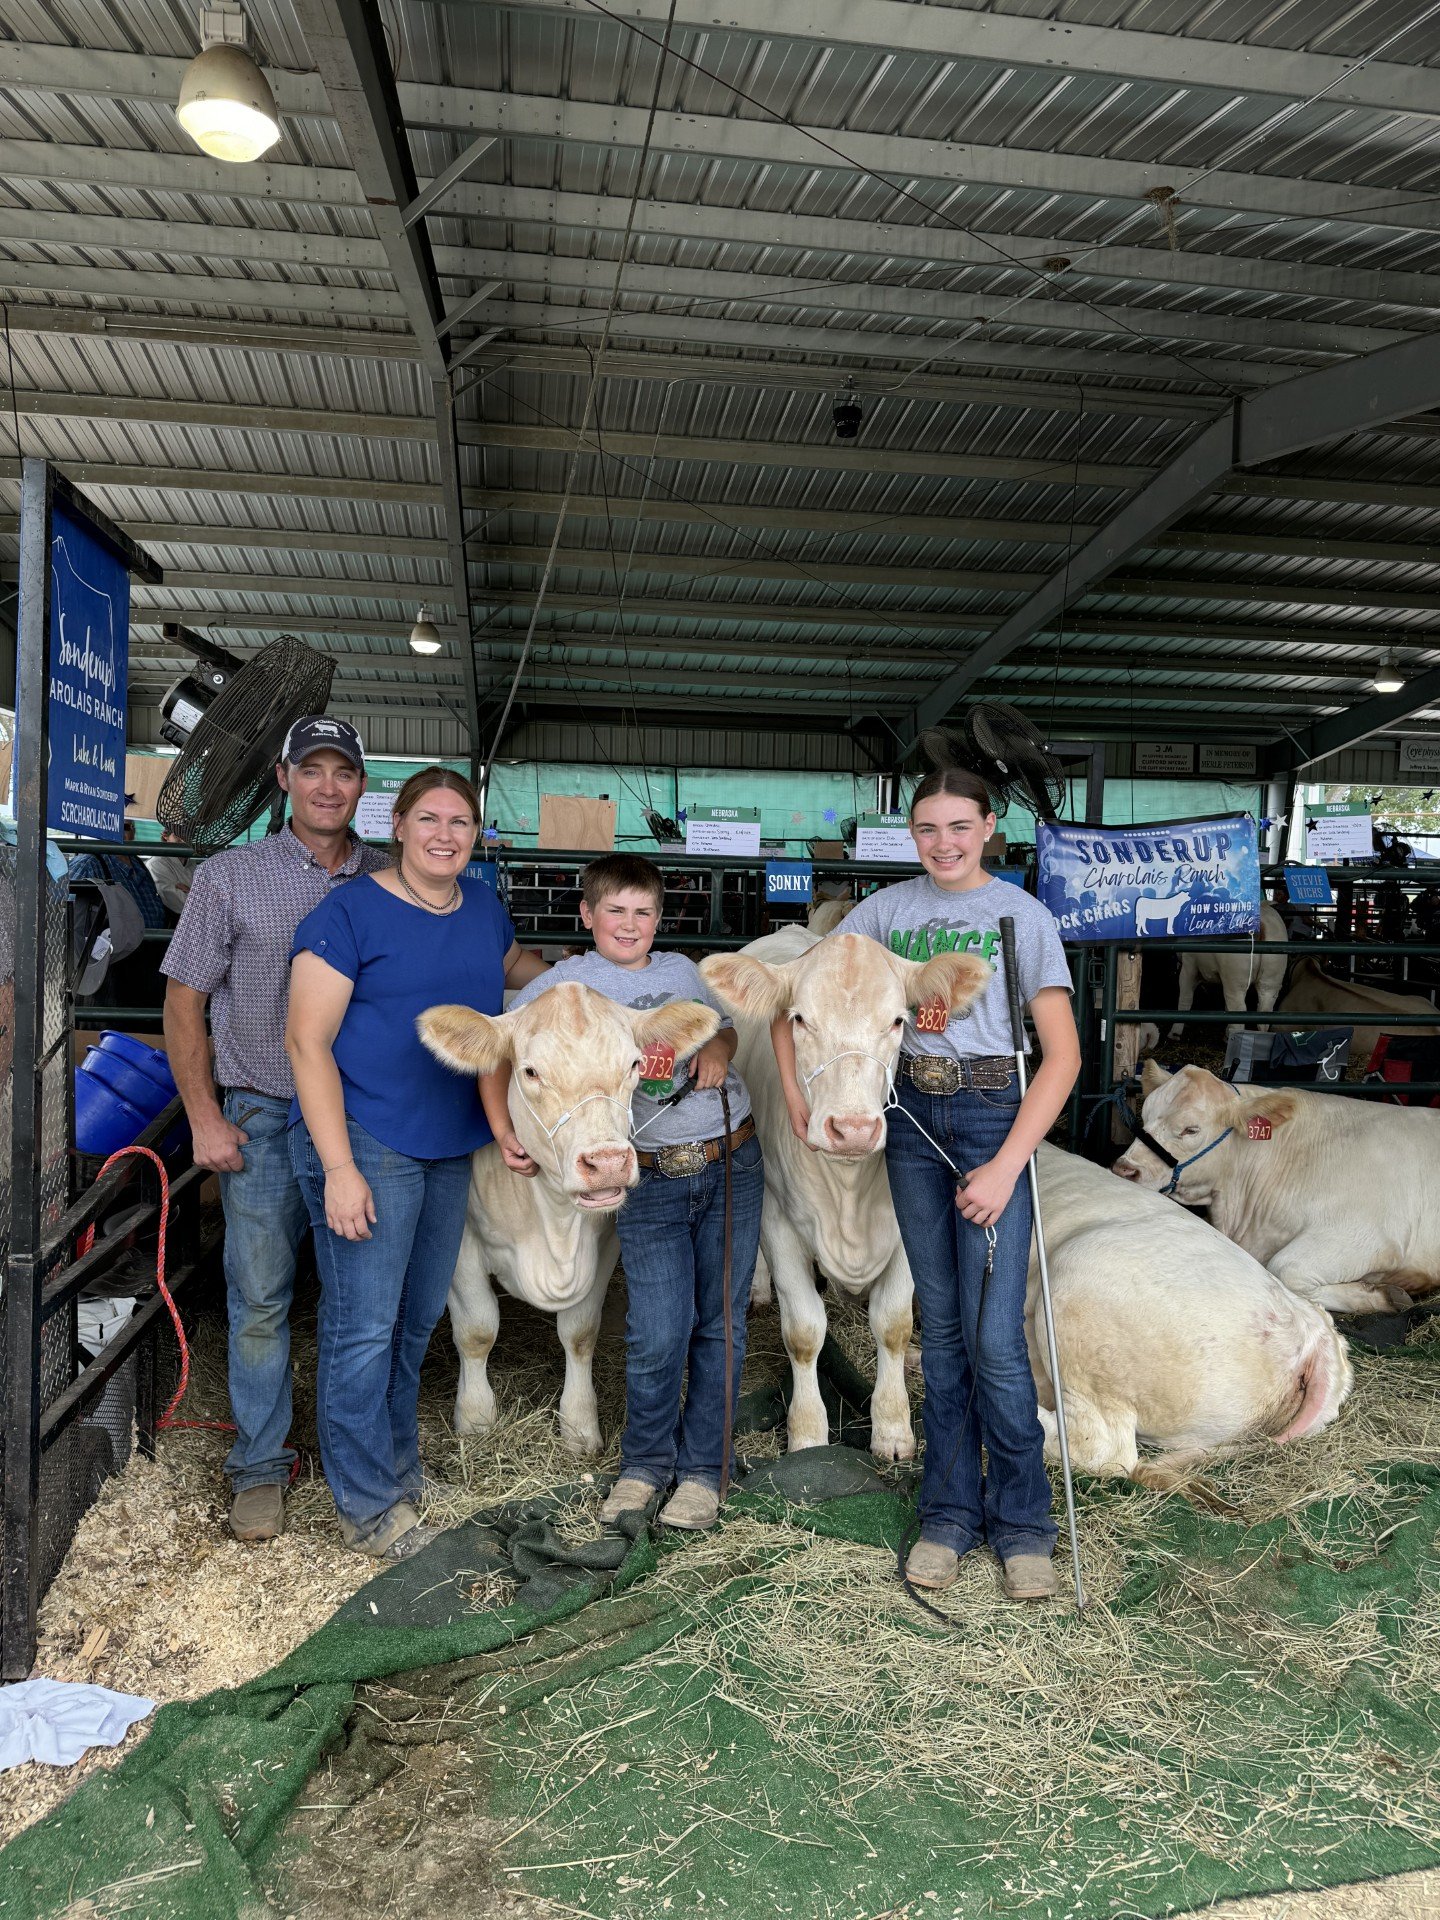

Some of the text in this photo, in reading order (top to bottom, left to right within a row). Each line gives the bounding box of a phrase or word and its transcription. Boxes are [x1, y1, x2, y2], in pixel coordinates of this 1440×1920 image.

[58, 611, 114, 702] Sonderup
[49, 677, 123, 730] AROLAIS RANCH
[382, 780, 405, 788] NEBRAS
[61, 801, 120, 832] SCRCHAROLAIS.COM
[711, 809, 738, 818] NEBRASKA
[1075, 832, 1232, 865] SONDERUP
[768, 874, 811, 892] SONNY
[1084, 864, 1226, 889] Charolais Ranch
[1291, 875, 1324, 886] STEVIE
[1296, 887, 1324, 899] NICKS
[1052, 898, 1131, 931] OCK CHARS
[1190, 902, 1255, 914] NOW SHOWING:
[1188, 914, 1214, 932] Lora
[1228, 914, 1255, 930] Luke
[916, 1008, 948, 1031] 3820
[656, 1040, 662, 1052] L
[639, 1054, 672, 1078] 3732
[1249, 1126, 1270, 1139] 3747
